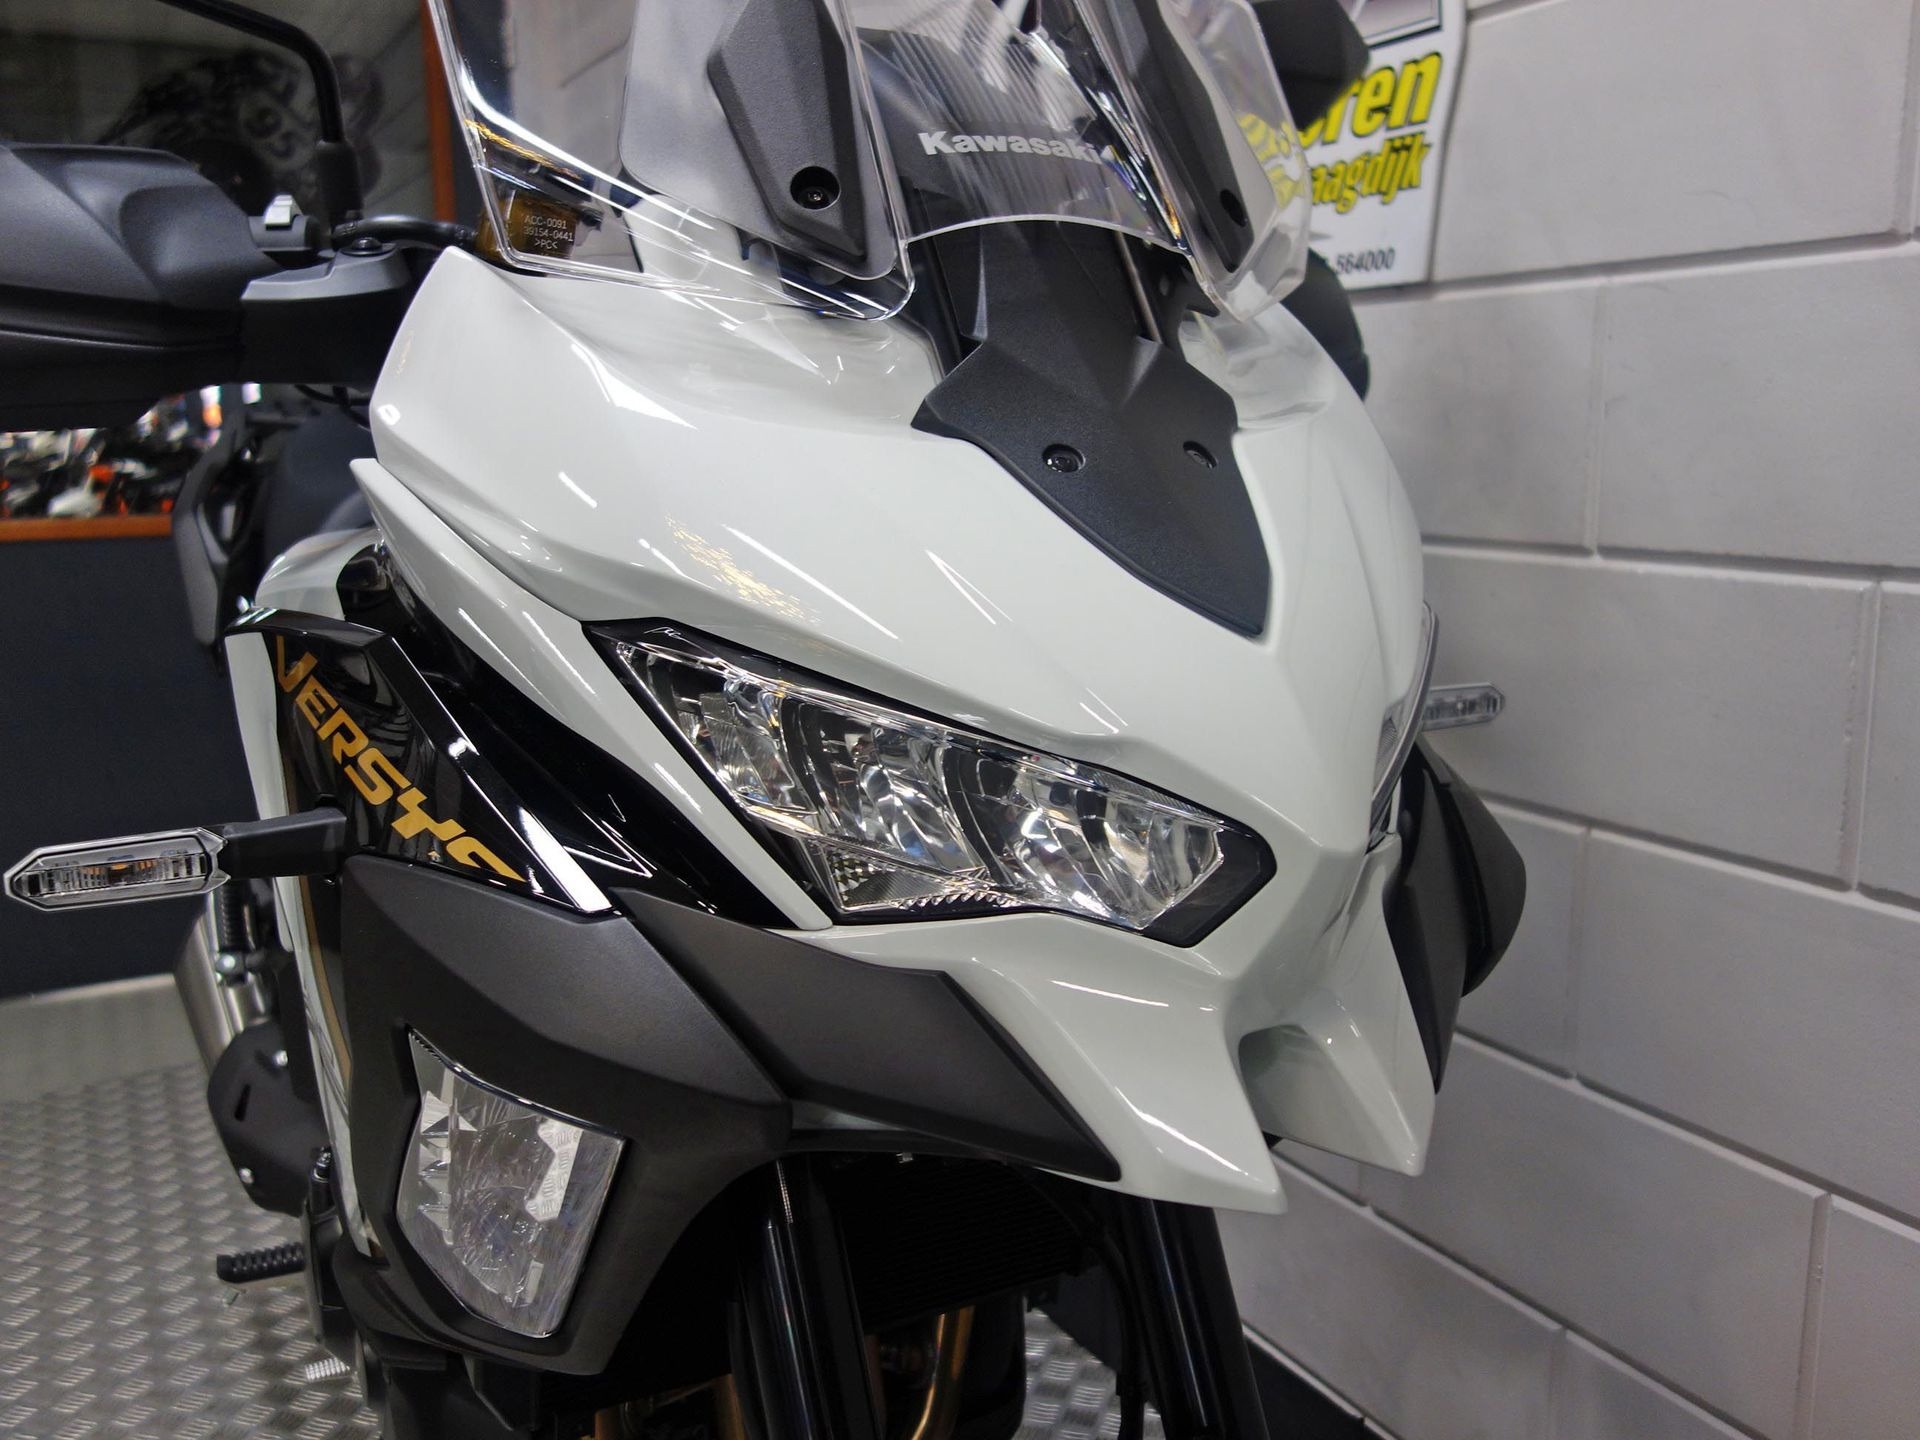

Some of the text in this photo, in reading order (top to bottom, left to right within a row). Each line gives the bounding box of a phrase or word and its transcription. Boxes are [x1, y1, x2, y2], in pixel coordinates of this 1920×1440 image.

[918, 131, 1102, 164] Kawasaki
[1310, 131, 1432, 214] aagdijk
[524, 215, 567, 229] ACC-0091
